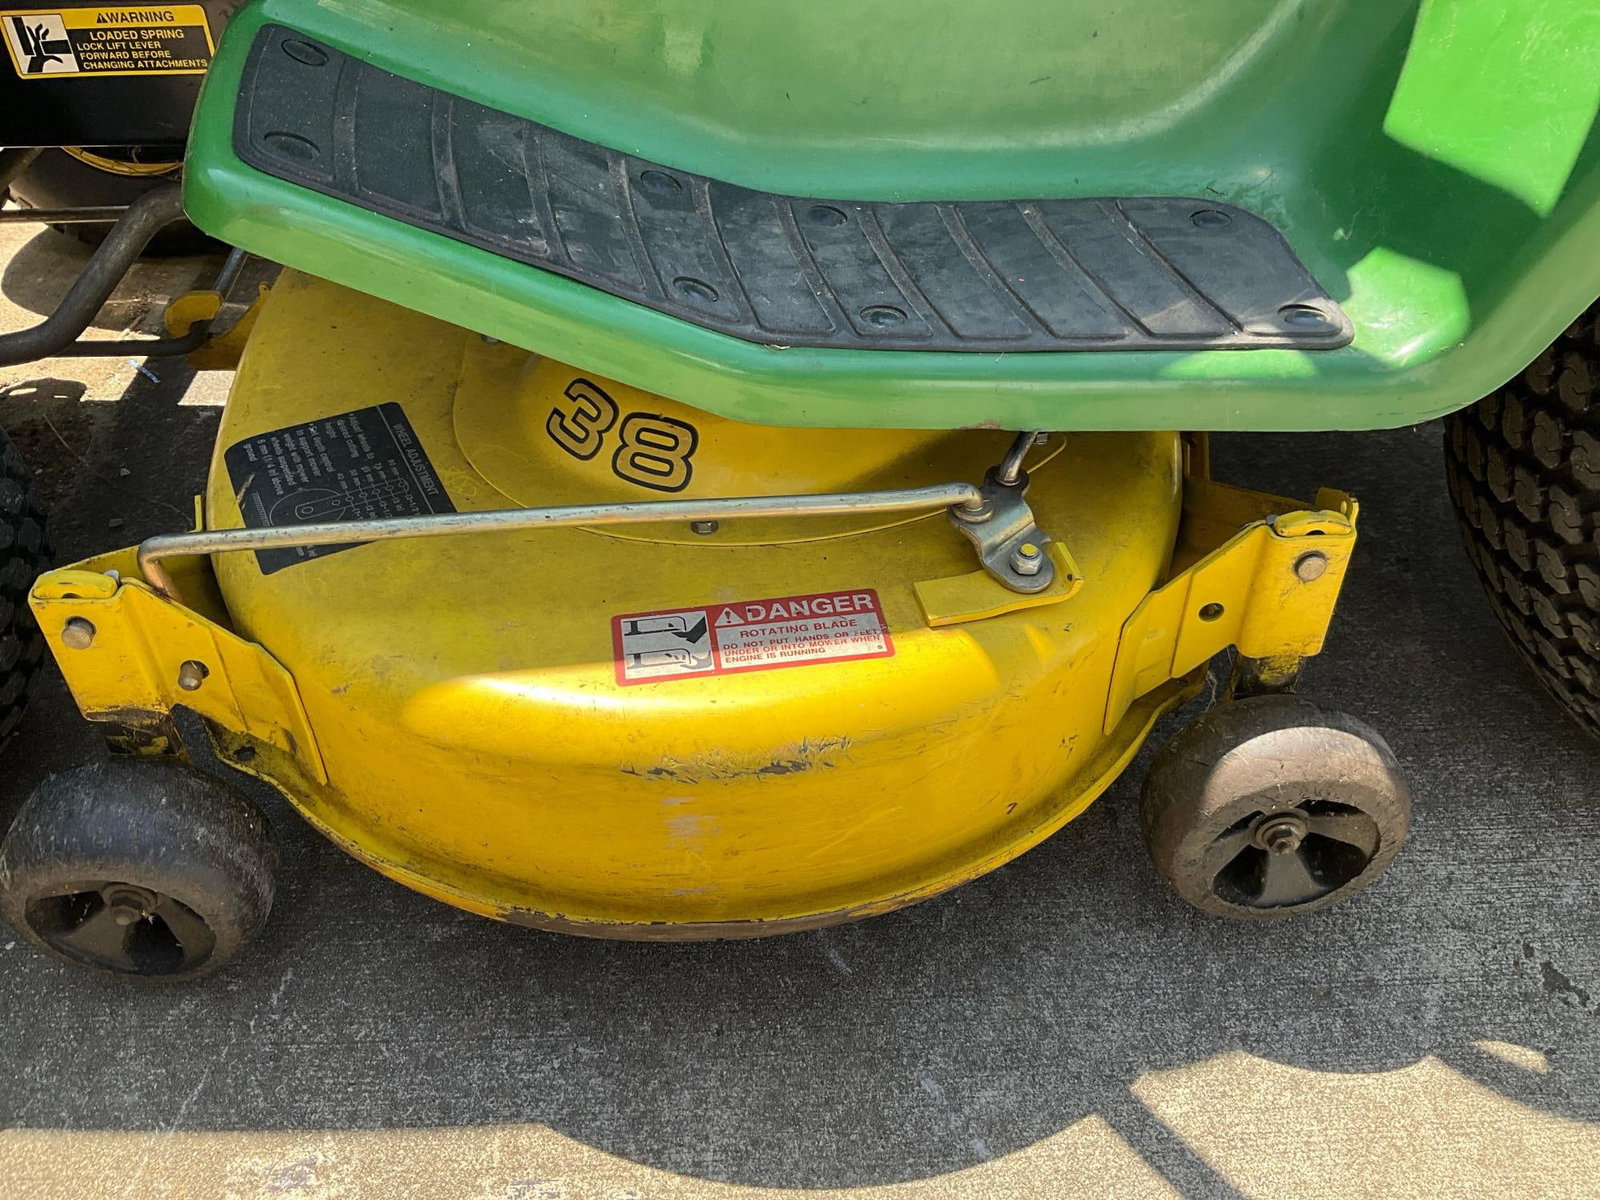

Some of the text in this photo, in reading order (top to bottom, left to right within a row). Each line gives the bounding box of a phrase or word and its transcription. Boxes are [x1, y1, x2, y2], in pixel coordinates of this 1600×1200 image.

[107, 11, 175, 23] WARNING
[90, 29, 184, 41] LOADED SPRING
[77, 41, 161, 50] LOCK LIFT LEVER
[80, 50, 171, 60] FORWARD BEFORE
[83, 59, 208, 70] CHANGING ATTACHMENTS
[546, 377, 699, 493] 38
[392, 423, 439, 495] WHEEL ADJUSTMENT
[746, 593, 874, 622] DANGER
[740, 618, 858, 638] ROTATING BLADE
[724, 648, 759, 657] UNDER
[781, 643, 805, 651] INTO
[809, 639, 848, 647] MOWER
[851, 635, 880, 643] WHEN
[743, 641, 765, 649] NOT
[770, 638, 788, 646] PUT
[794, 634, 829, 643] HANDS
[725, 654, 763, 664] ENGINE
[779, 648, 826, 658] RUNNING
